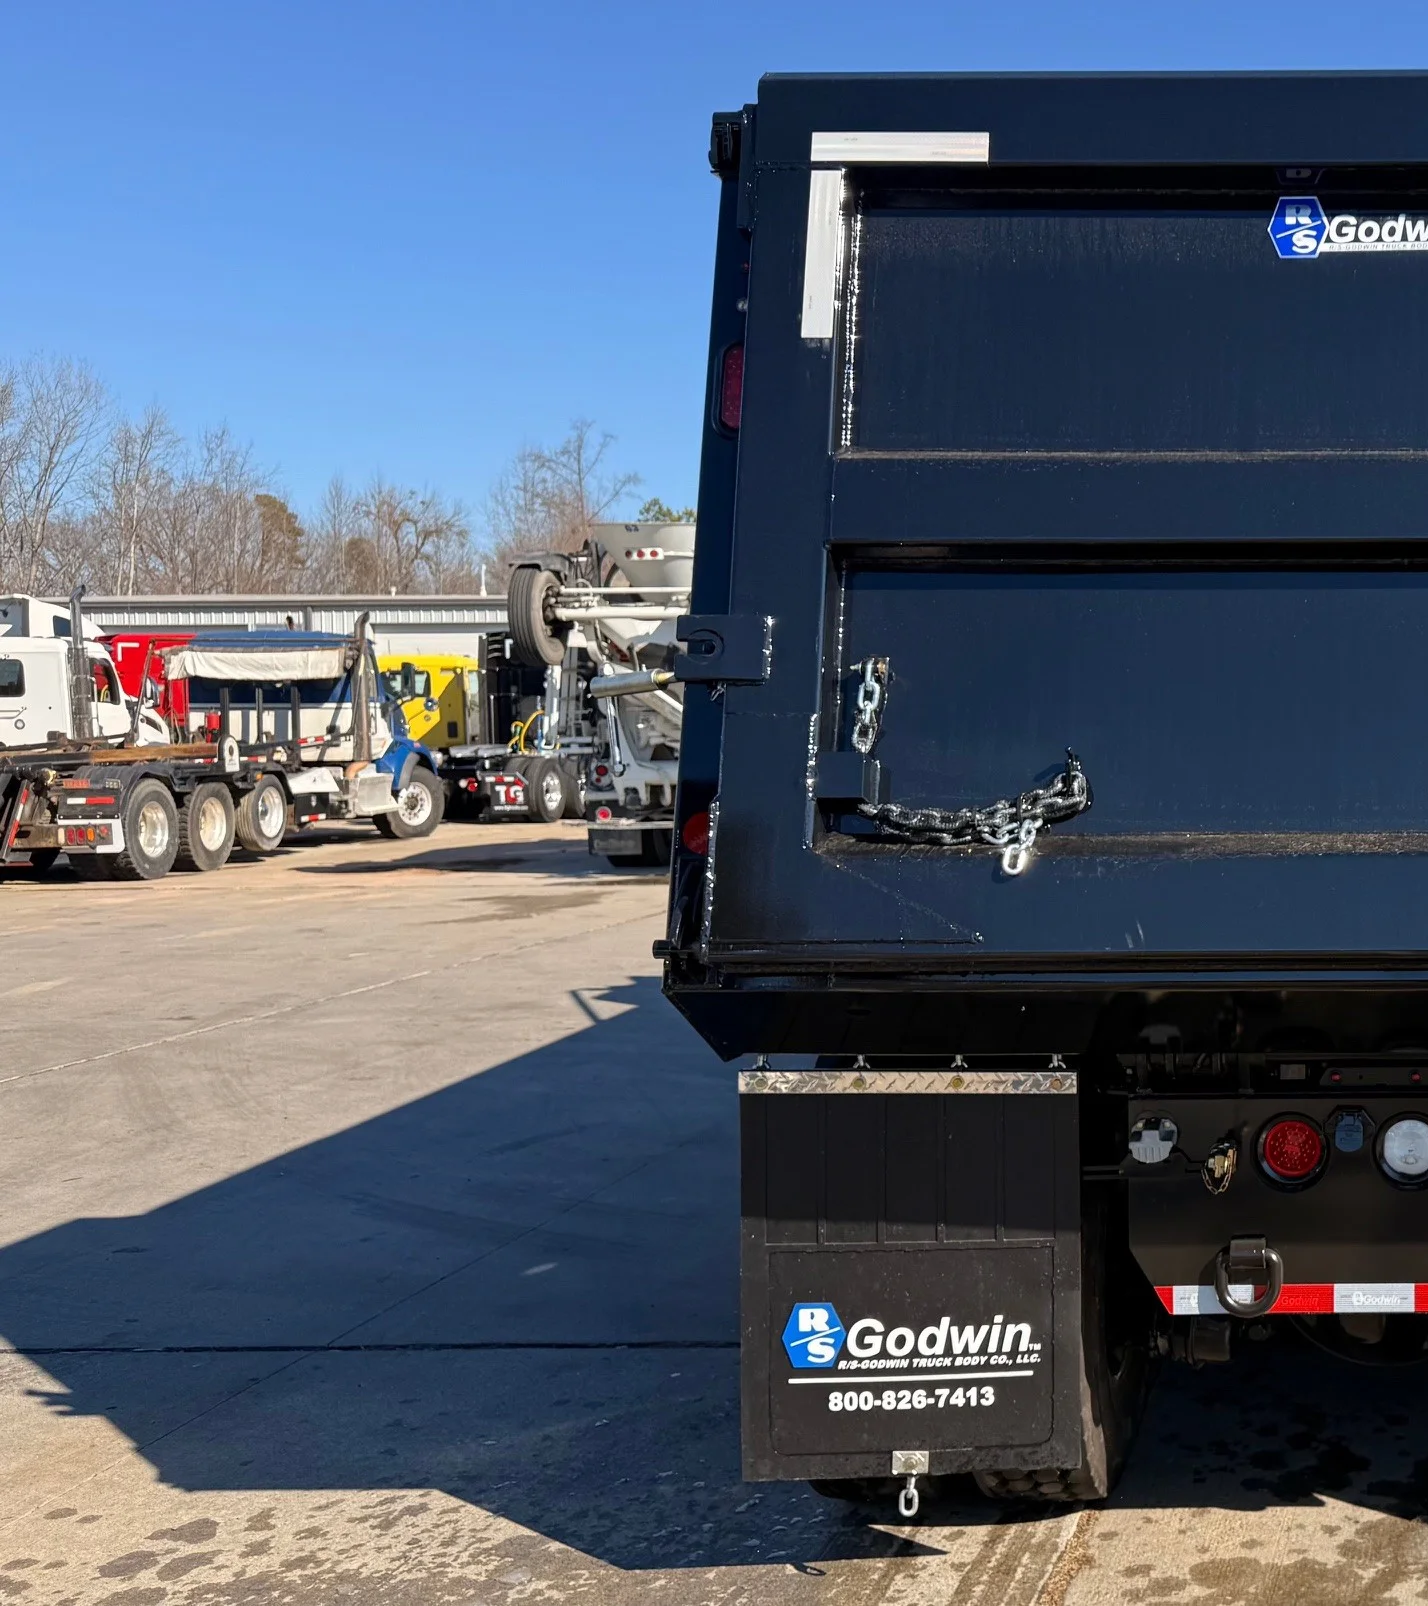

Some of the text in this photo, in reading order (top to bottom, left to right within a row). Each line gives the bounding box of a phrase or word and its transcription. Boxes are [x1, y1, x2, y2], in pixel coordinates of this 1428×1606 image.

[494, 783, 525, 805] TG
[1363, 1295, 1401, 1305] Godwin
[846, 1315, 1032, 1358] Godwin
[837, 1358, 909, 1370] R/S-GODWIN
[912, 1357, 952, 1368] TRUCK
[954, 1355, 988, 1366] BODY
[828, 1386, 995, 1411] 800-826-7413
